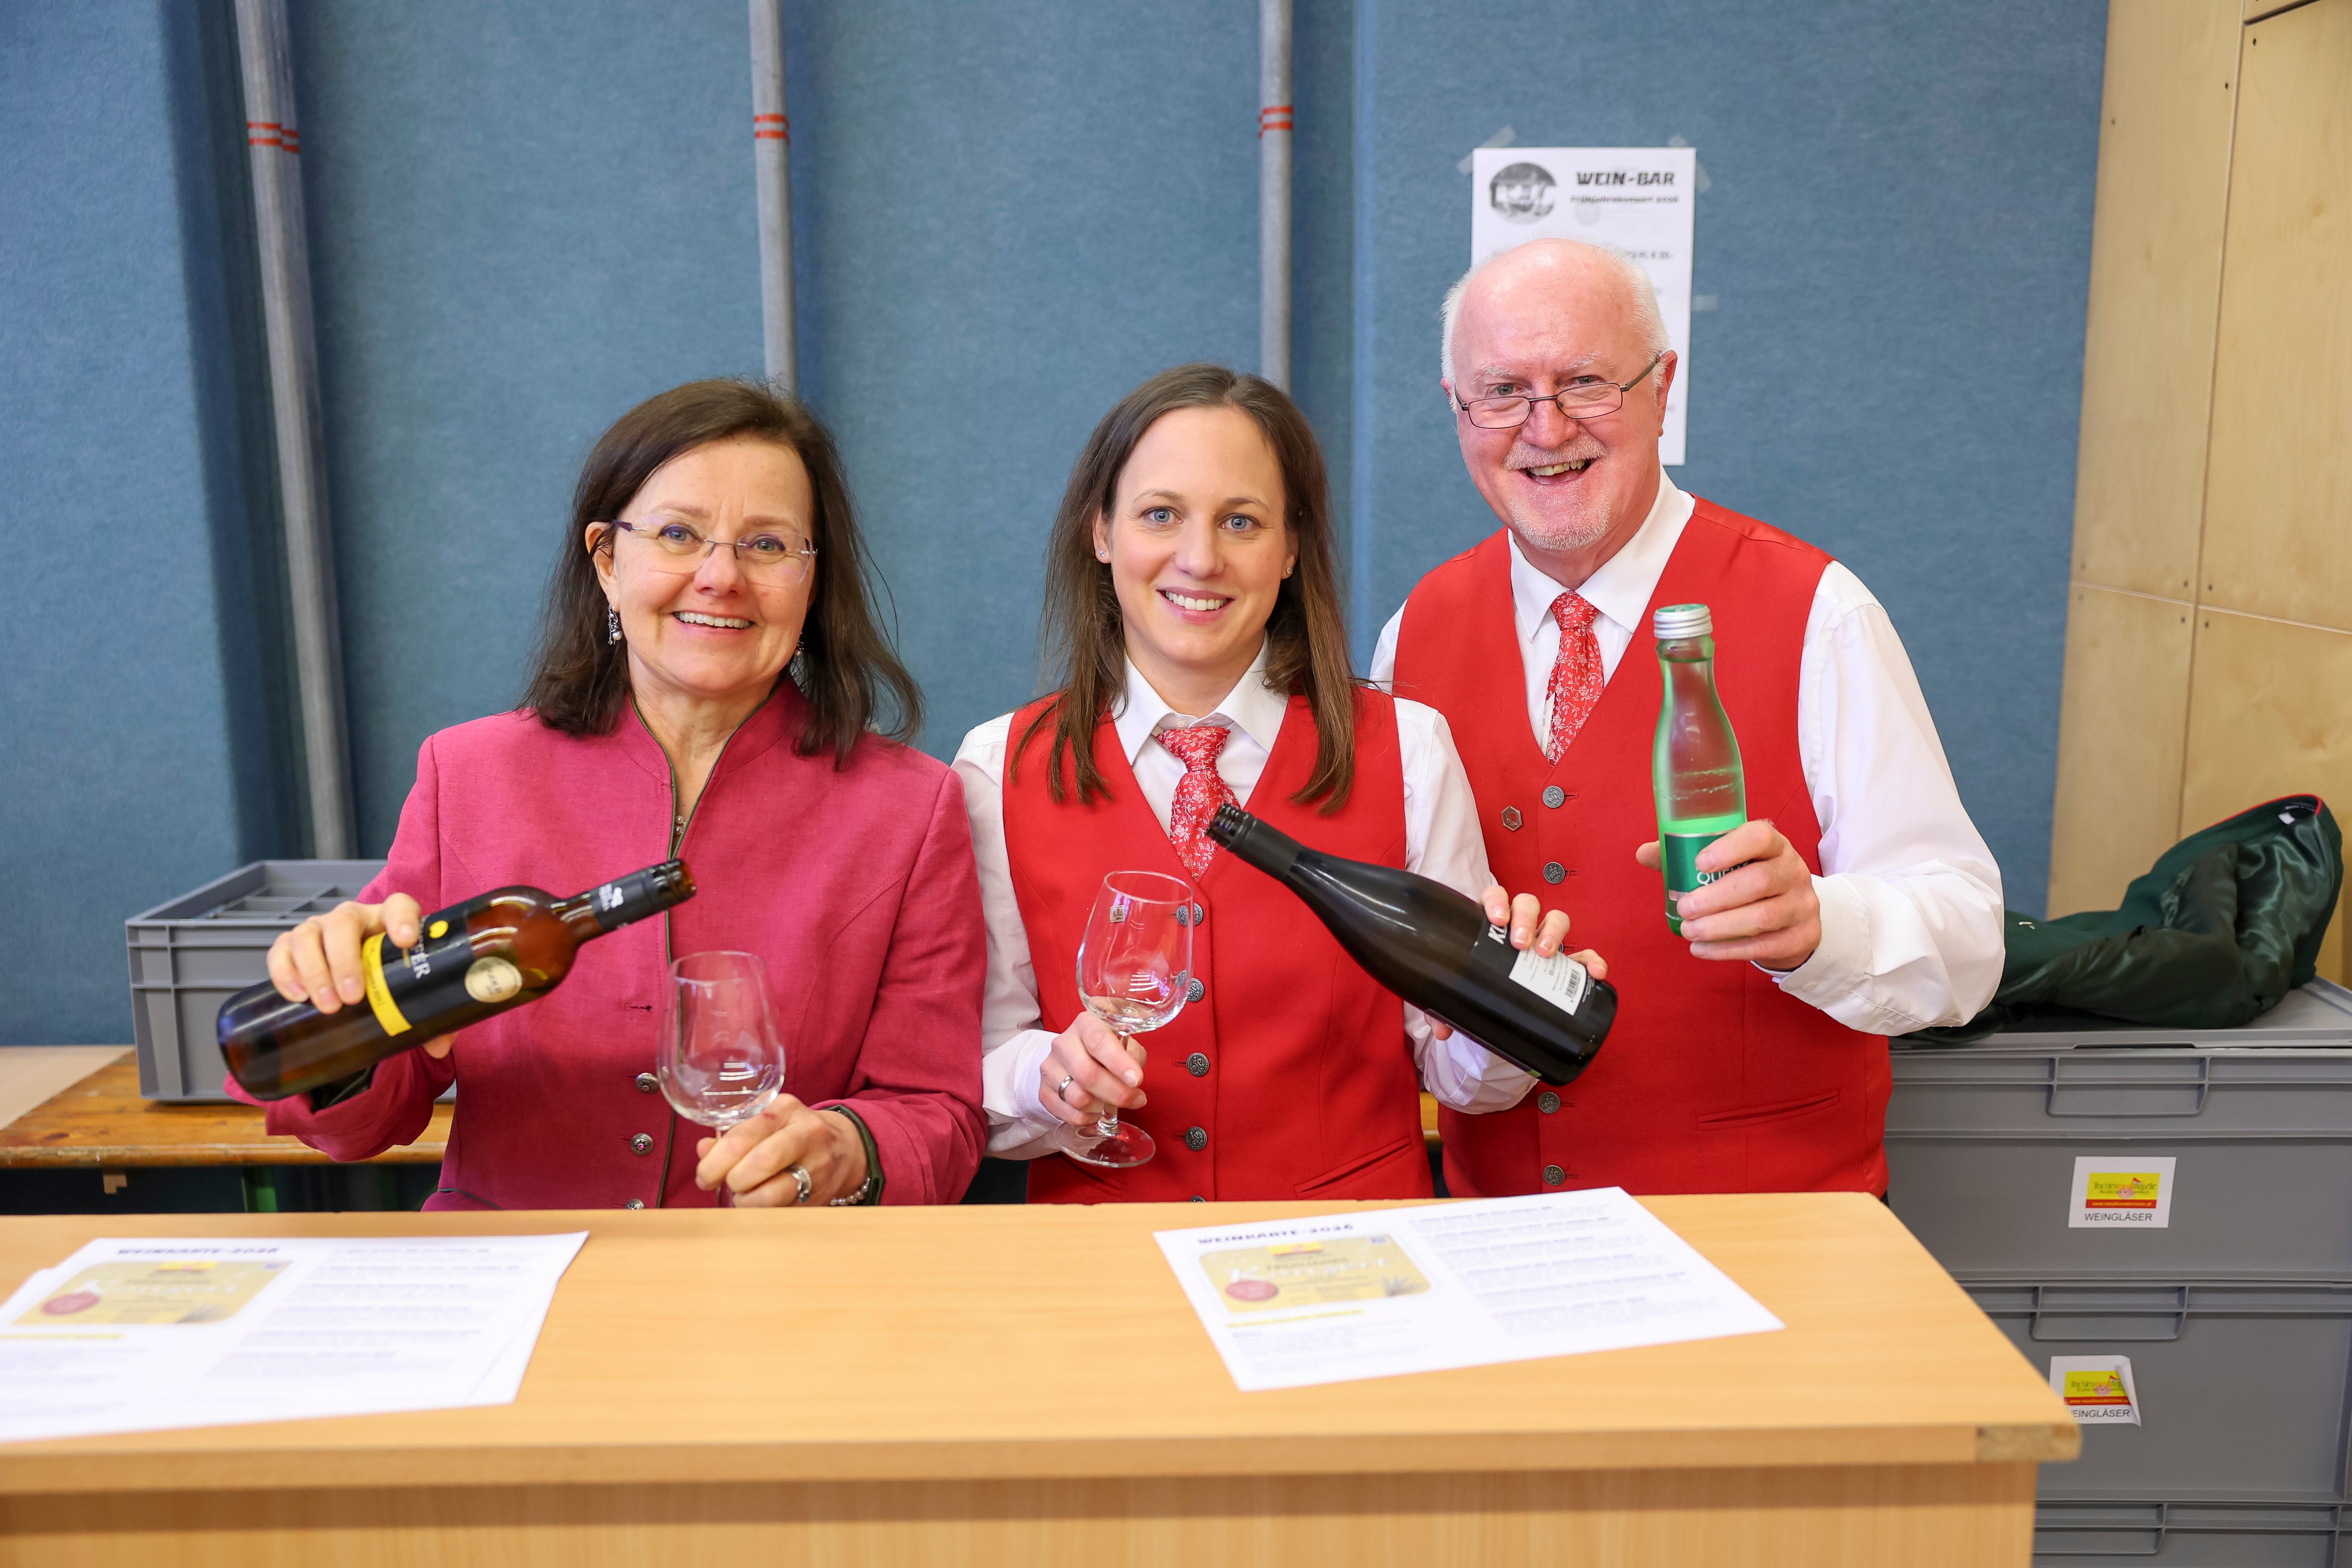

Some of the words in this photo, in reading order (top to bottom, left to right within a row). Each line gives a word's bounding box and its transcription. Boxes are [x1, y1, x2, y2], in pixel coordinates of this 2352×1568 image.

[1577, 172, 1674, 185] WEIN-BAR
[2084, 1211, 2153, 1222] WEINGLÄSER
[2069, 1408, 2131, 1418] EINGLÄSER
